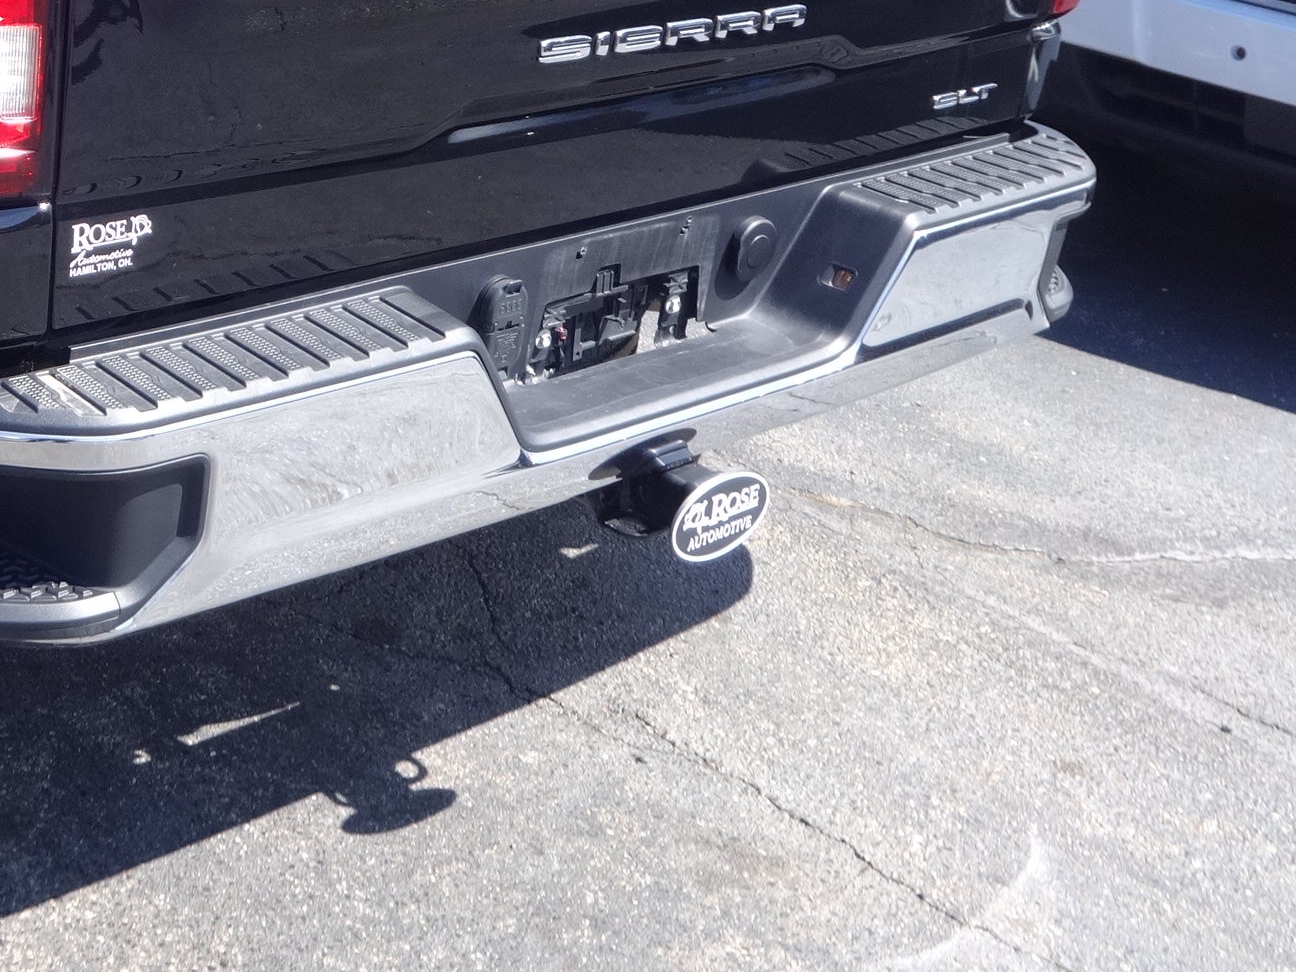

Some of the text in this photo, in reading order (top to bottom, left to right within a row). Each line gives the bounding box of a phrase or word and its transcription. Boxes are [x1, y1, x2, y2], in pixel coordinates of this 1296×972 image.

[538, 3, 808, 64] SIERRA
[932, 82, 999, 111] SLT
[71, 219, 128, 254] ROSE
[69, 248, 135, 268] Automotive
[69, 257, 134, 278] HAMILTON, OH.
[709, 483, 761, 526] ROSE
[687, 514, 753, 552] AUTOMOTIVE
